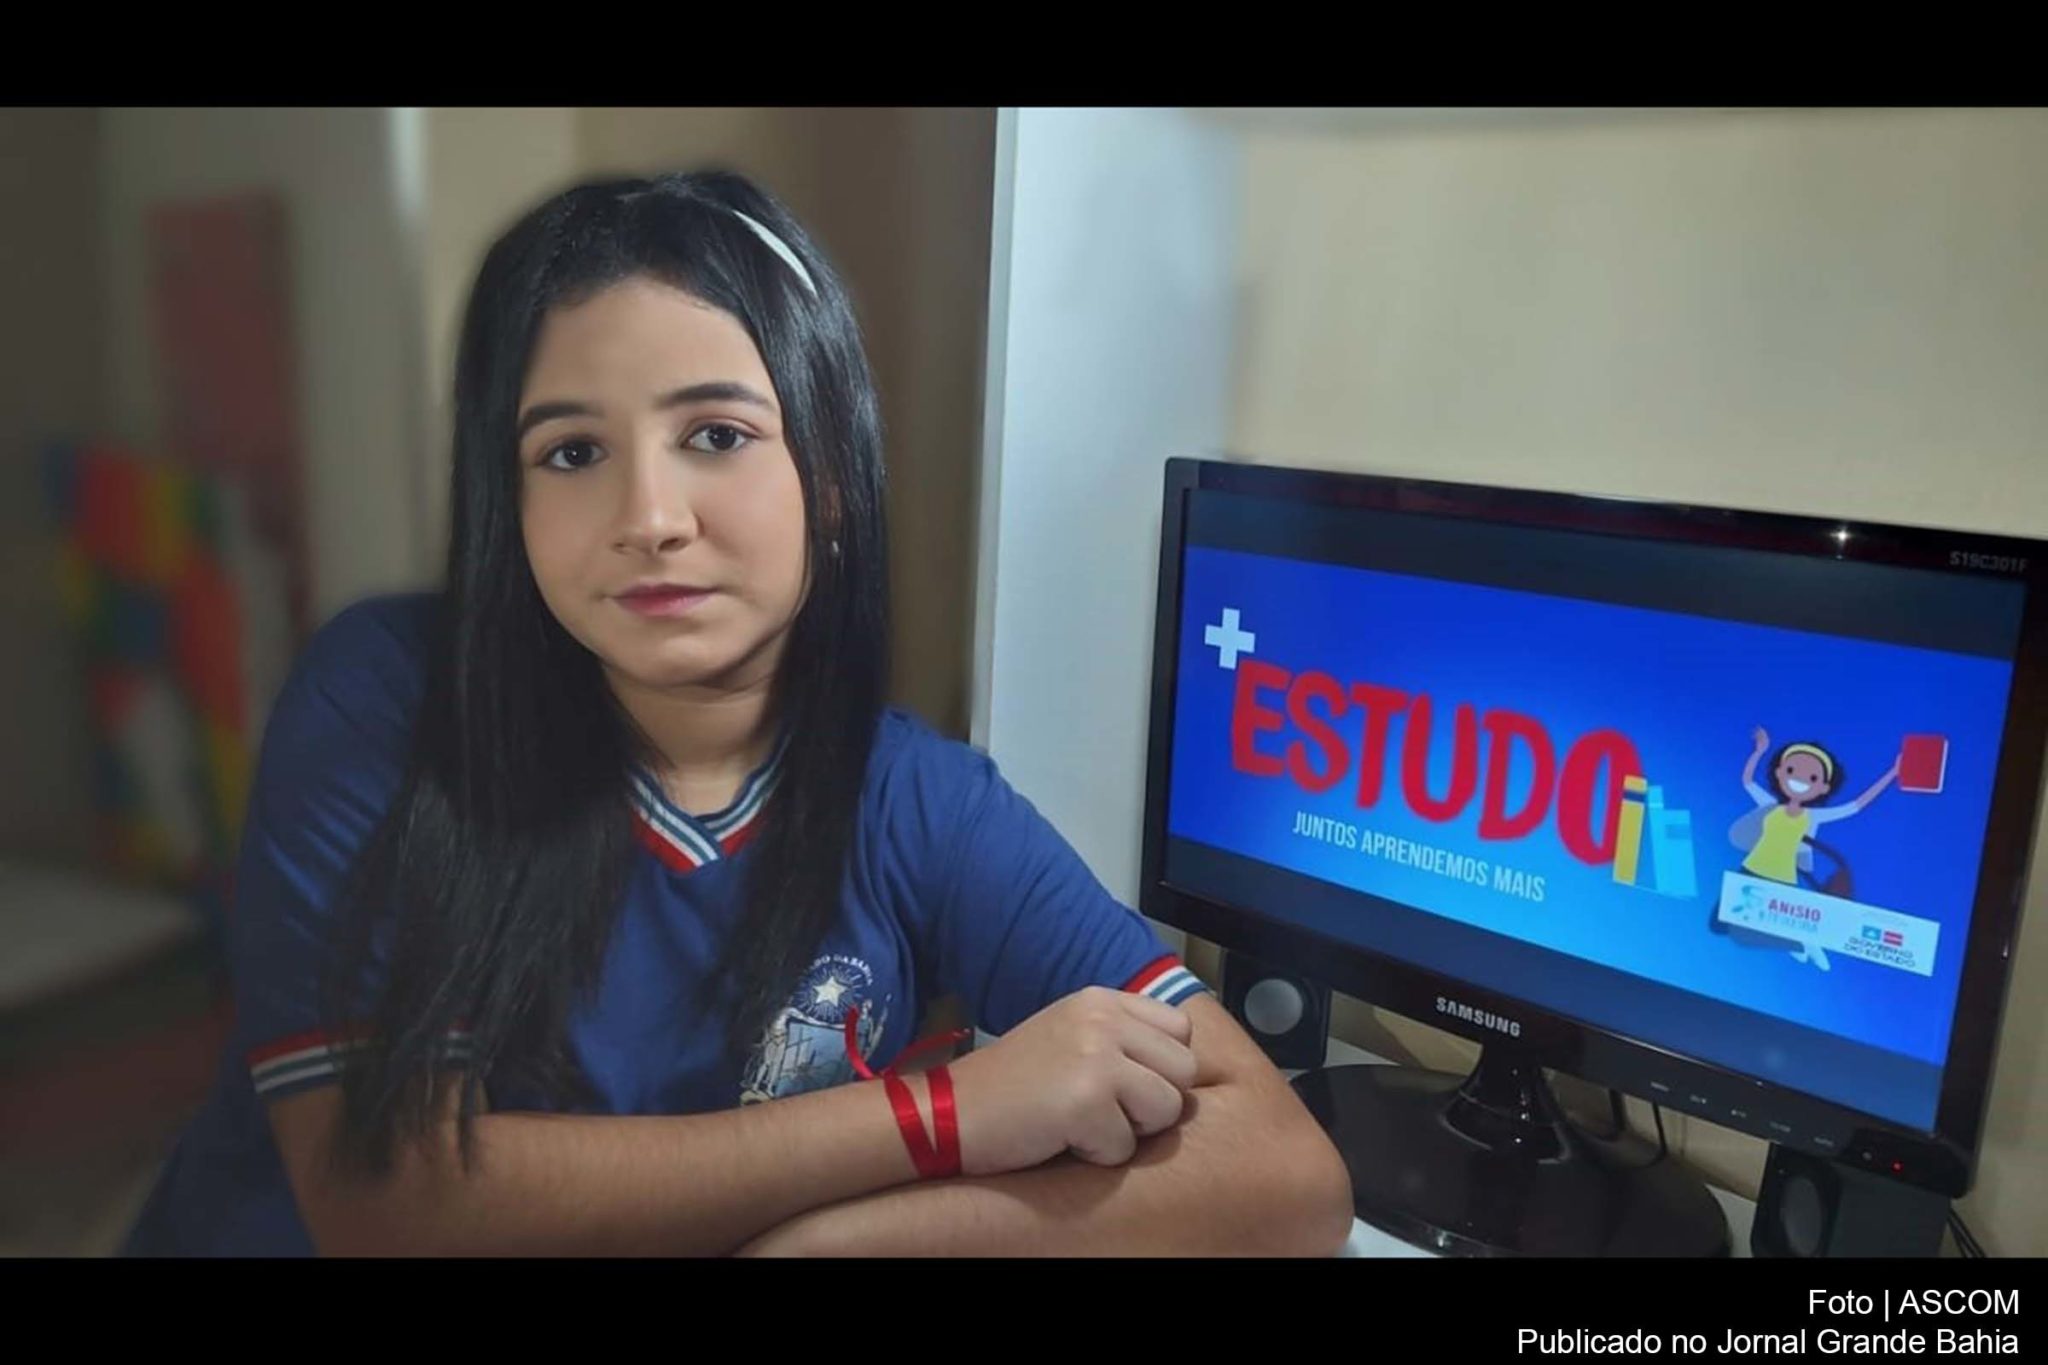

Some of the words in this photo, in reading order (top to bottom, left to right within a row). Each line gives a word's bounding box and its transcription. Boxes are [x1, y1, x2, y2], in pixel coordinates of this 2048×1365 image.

[1232, 658, 1645, 866] ESTUDO
[1292, 810, 1358, 849] JUNTOS
[1361, 830, 1489, 887] APRENDEMOS
[1494, 865, 1546, 903] MAIS
[1436, 996, 1521, 1037] SAMSUNG
